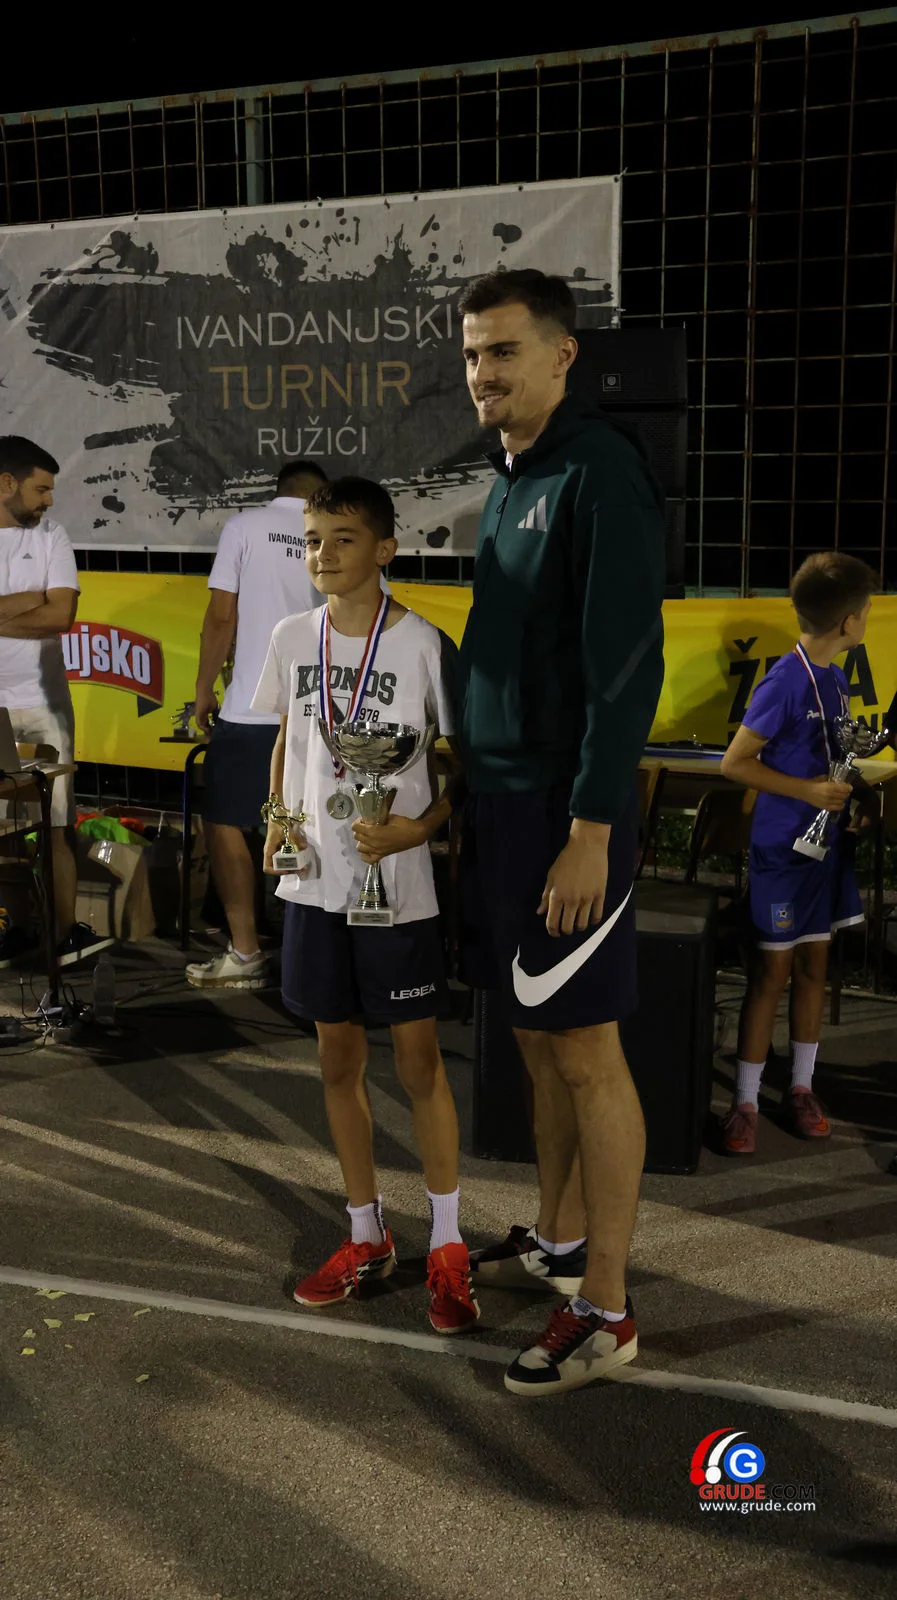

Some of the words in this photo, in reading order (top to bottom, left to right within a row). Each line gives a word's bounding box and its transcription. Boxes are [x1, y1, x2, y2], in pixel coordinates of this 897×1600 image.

[177, 303, 452, 349] IVANDANJSKI
[208, 360, 411, 410] TURNIR
[257, 415, 367, 456] RUŽIĆI
[268, 532, 306, 548] IVANDANS
[61, 624, 151, 685] ujsko
[358, 707, 380, 722] 978
[390, 982, 437, 1000] LEGEA
